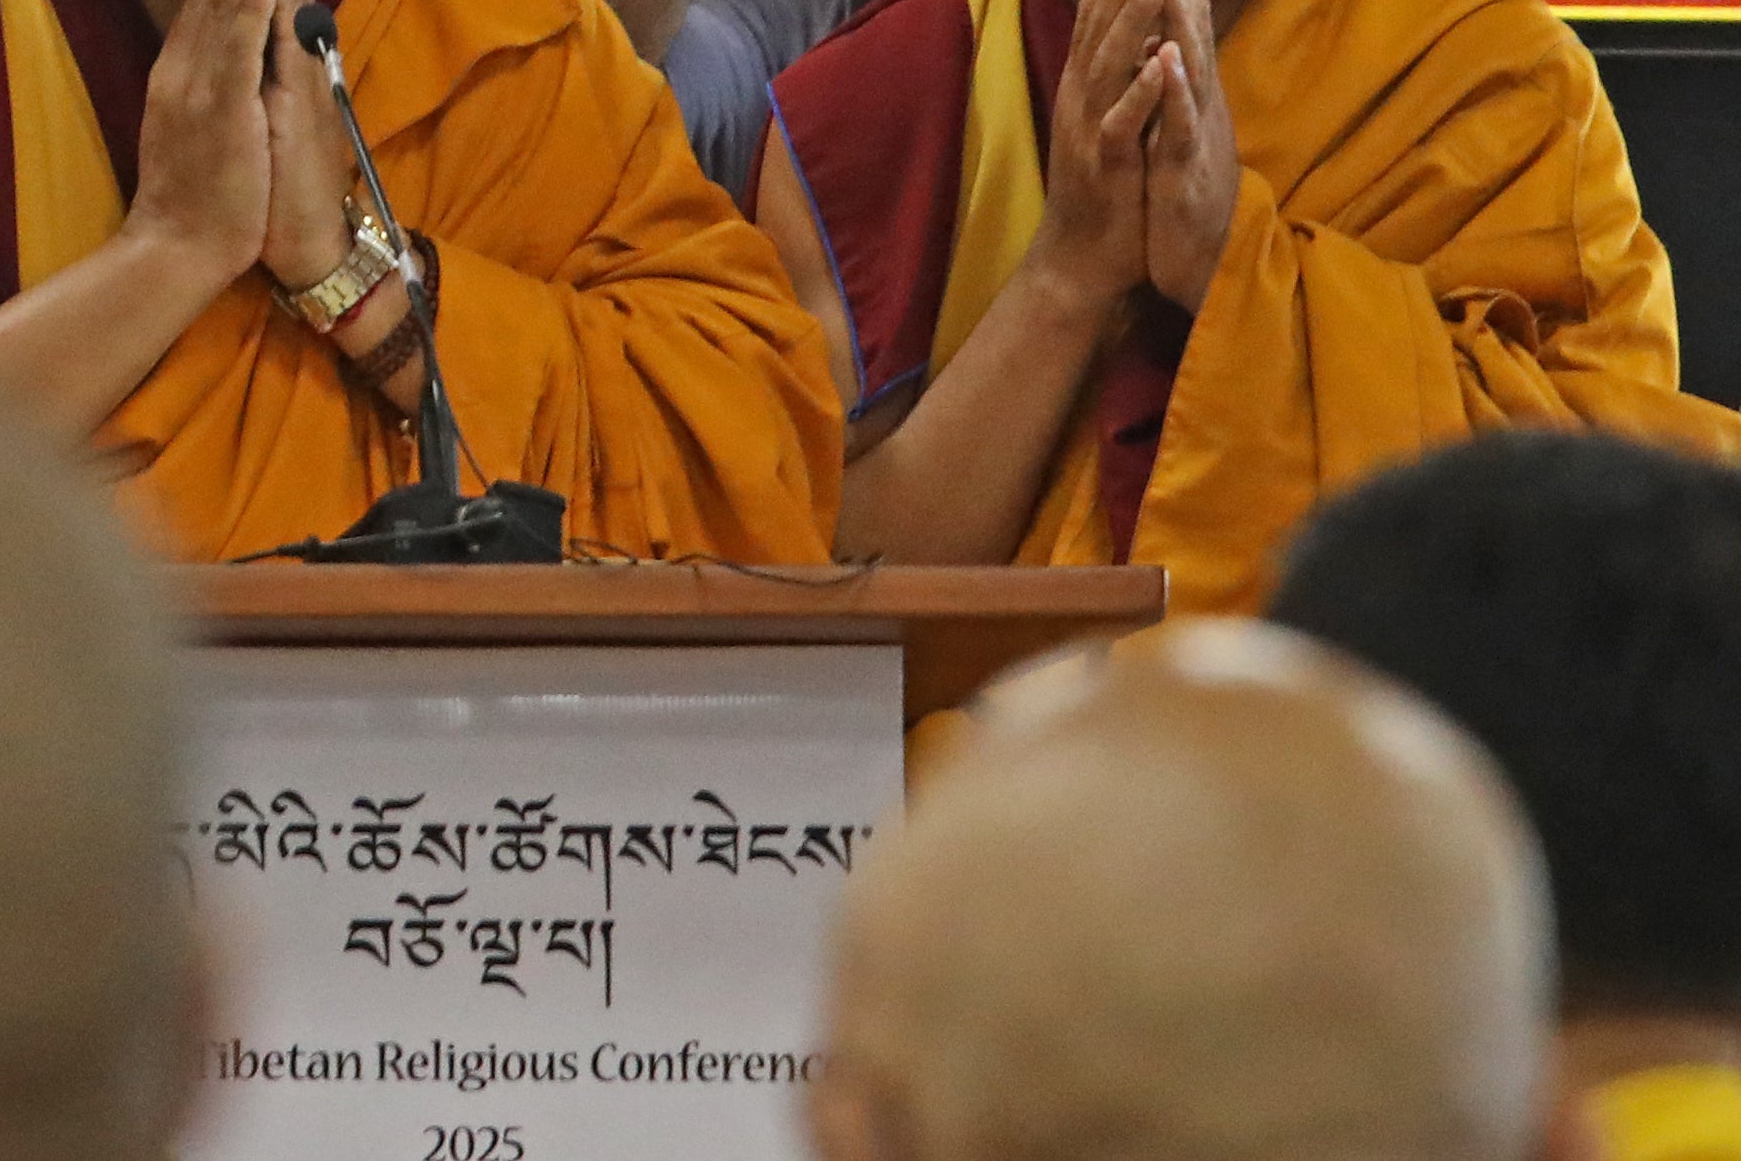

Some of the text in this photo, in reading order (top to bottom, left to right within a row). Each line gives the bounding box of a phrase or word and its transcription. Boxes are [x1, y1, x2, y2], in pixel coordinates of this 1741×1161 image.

[207, 1037, 825, 1092] ibetan Religious Conferenc
[422, 1124, 525, 1161] 2025
